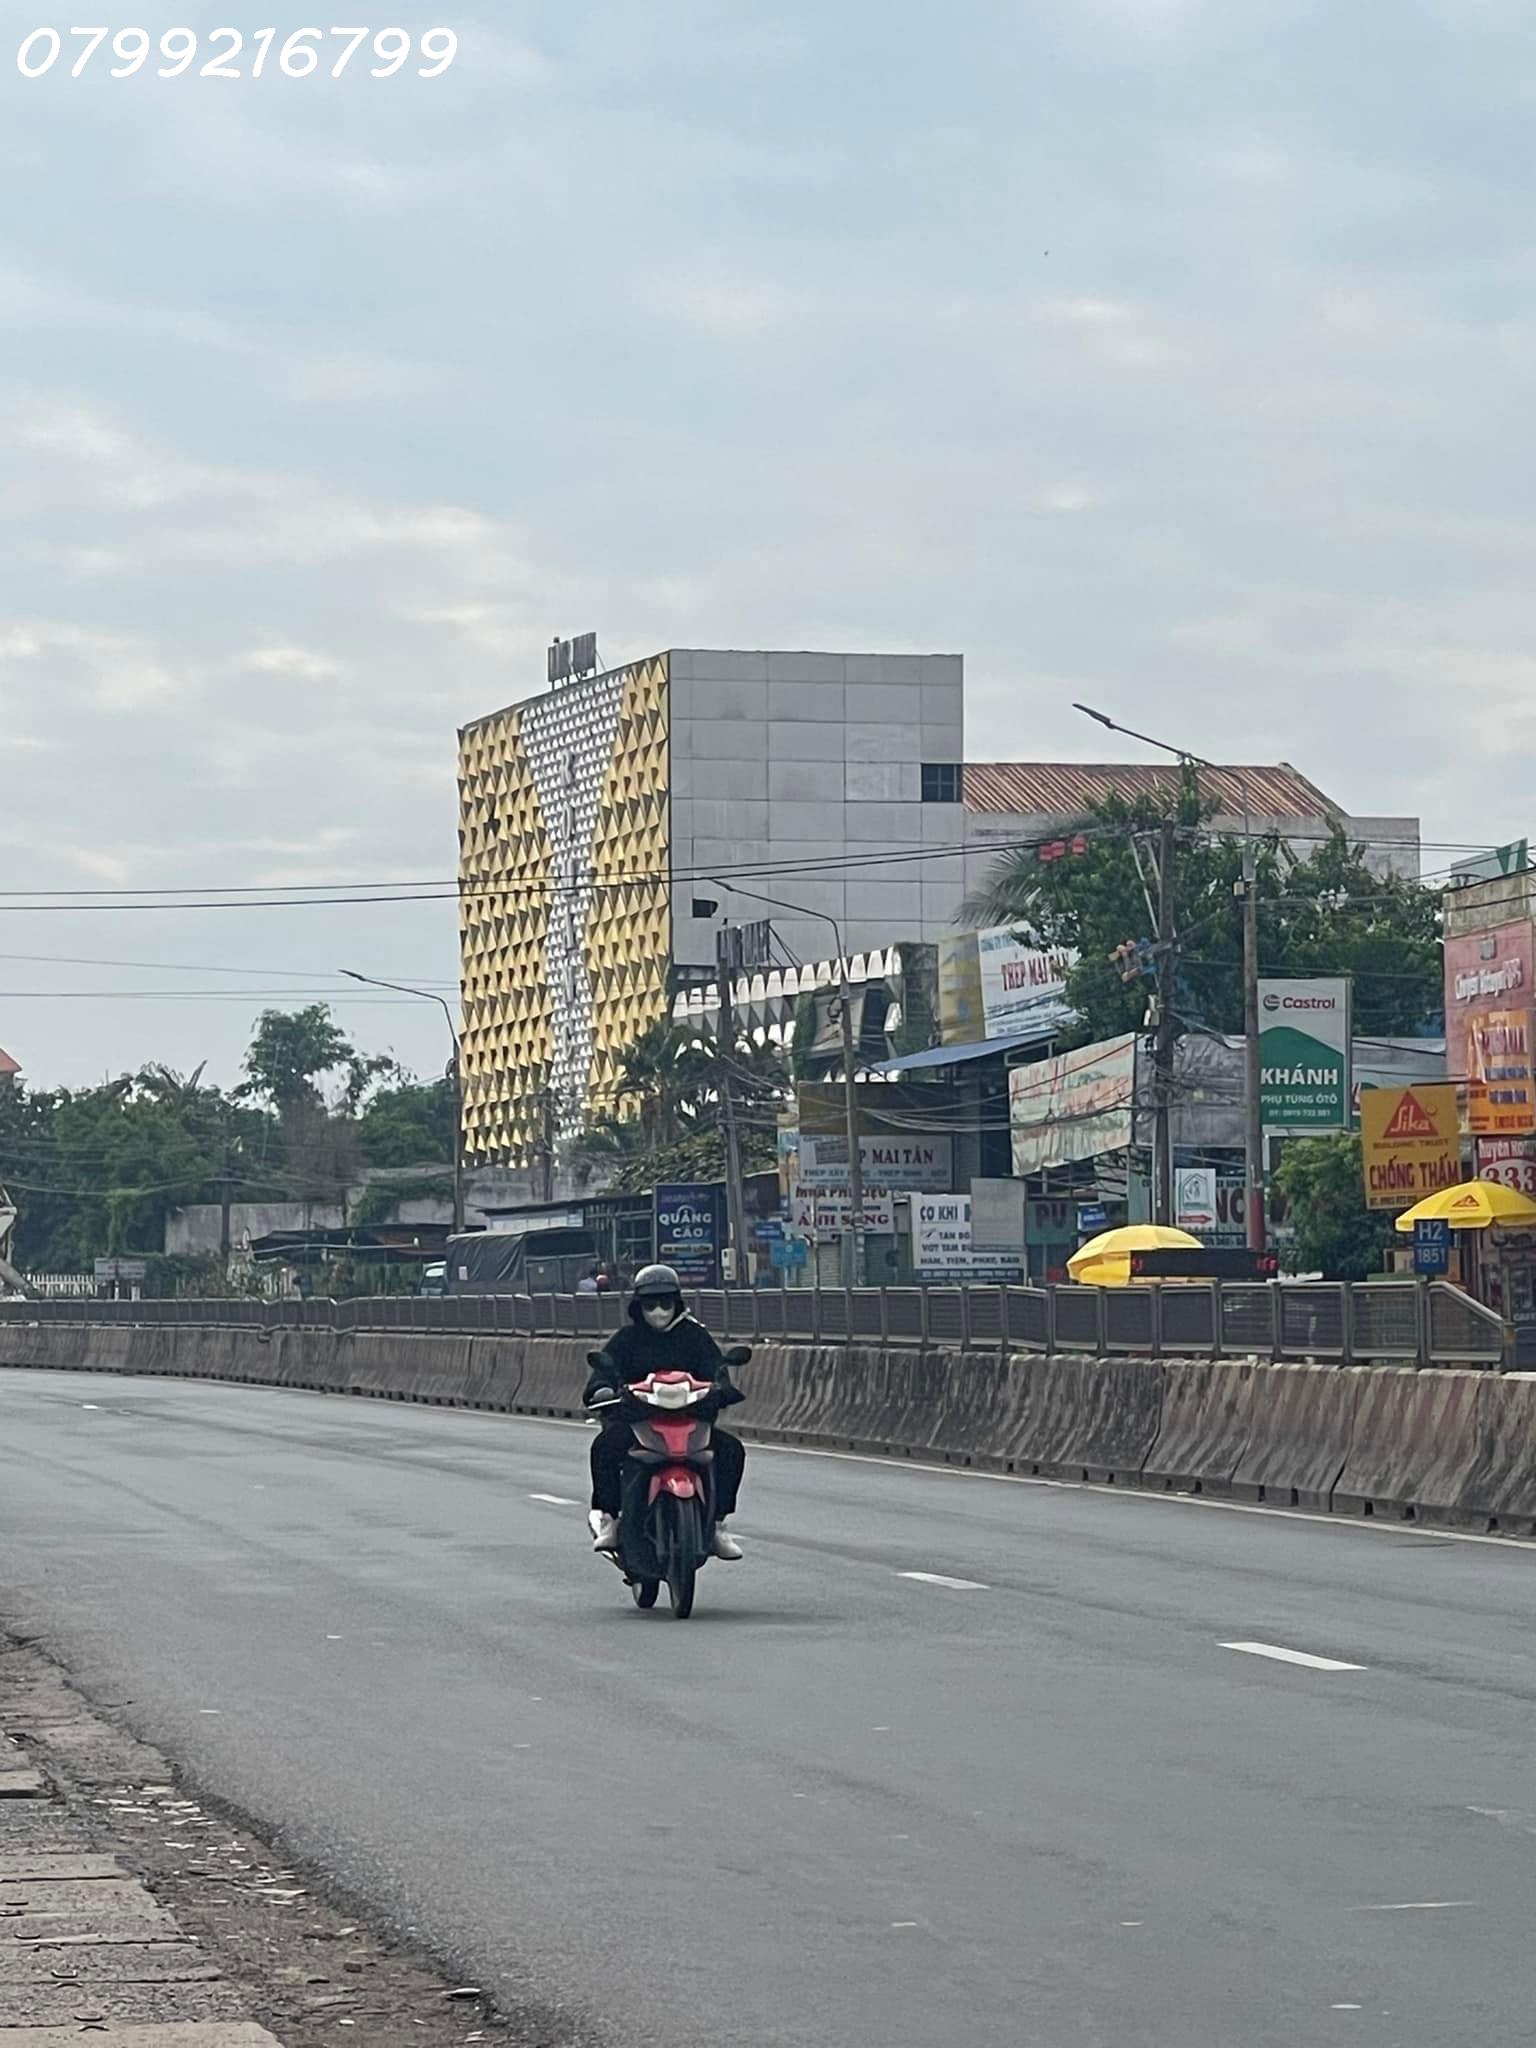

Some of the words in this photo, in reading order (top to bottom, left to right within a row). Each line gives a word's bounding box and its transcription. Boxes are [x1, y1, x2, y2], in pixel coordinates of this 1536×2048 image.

[1282, 997, 1336, 1009] Castrol
[1260, 1062, 1338, 1085] KHÁNH
[1390, 1105, 1430, 1132] Sika
[871, 1149, 899, 1164] MAI
[1369, 1155, 1415, 1190] CHỐNG
[1419, 1152, 1459, 1187] THẤM
[658, 1210, 712, 1226] QUẢNG
[1418, 1221, 1443, 1240] H2
[1417, 1248, 1445, 1264] 1851
